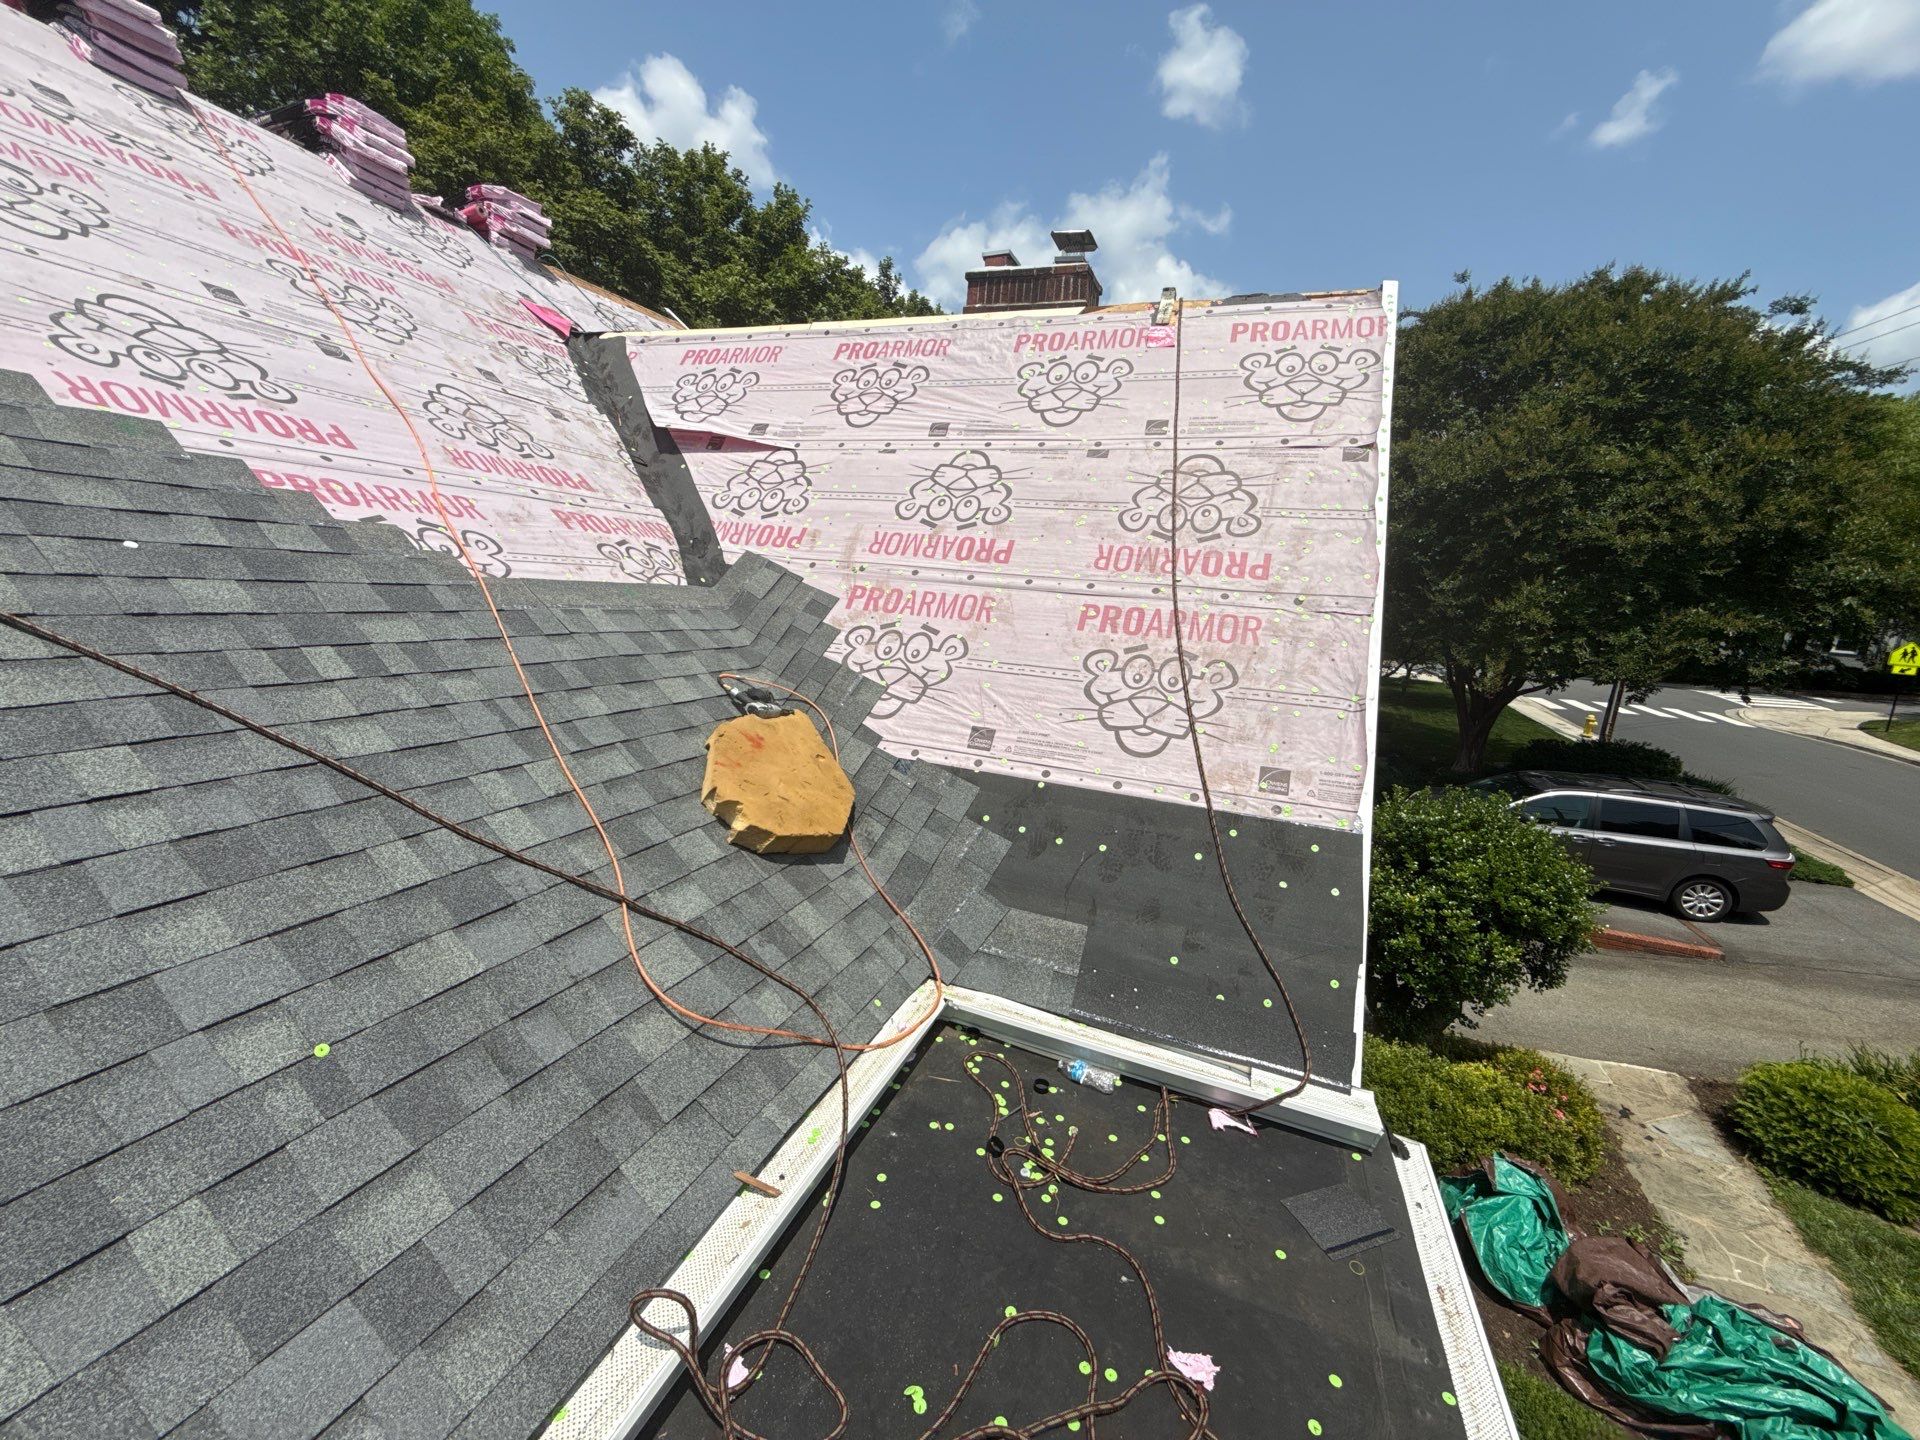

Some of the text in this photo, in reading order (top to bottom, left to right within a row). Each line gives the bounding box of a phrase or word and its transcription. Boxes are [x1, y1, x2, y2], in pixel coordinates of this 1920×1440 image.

[679, 345, 784, 366] PROARMOR
[832, 338, 952, 361] PROARMOR
[52, 370, 358, 450] PROARMOR
[442, 445, 598, 493] PROARMOR
[711, 520, 808, 549] PROARM
[868, 531, 1015, 565] PROARMOR
[1094, 544, 1273, 580] PROARMOR
[845, 584, 996, 623] PROARMOR
[1076, 603, 1263, 646] PROARMOR
